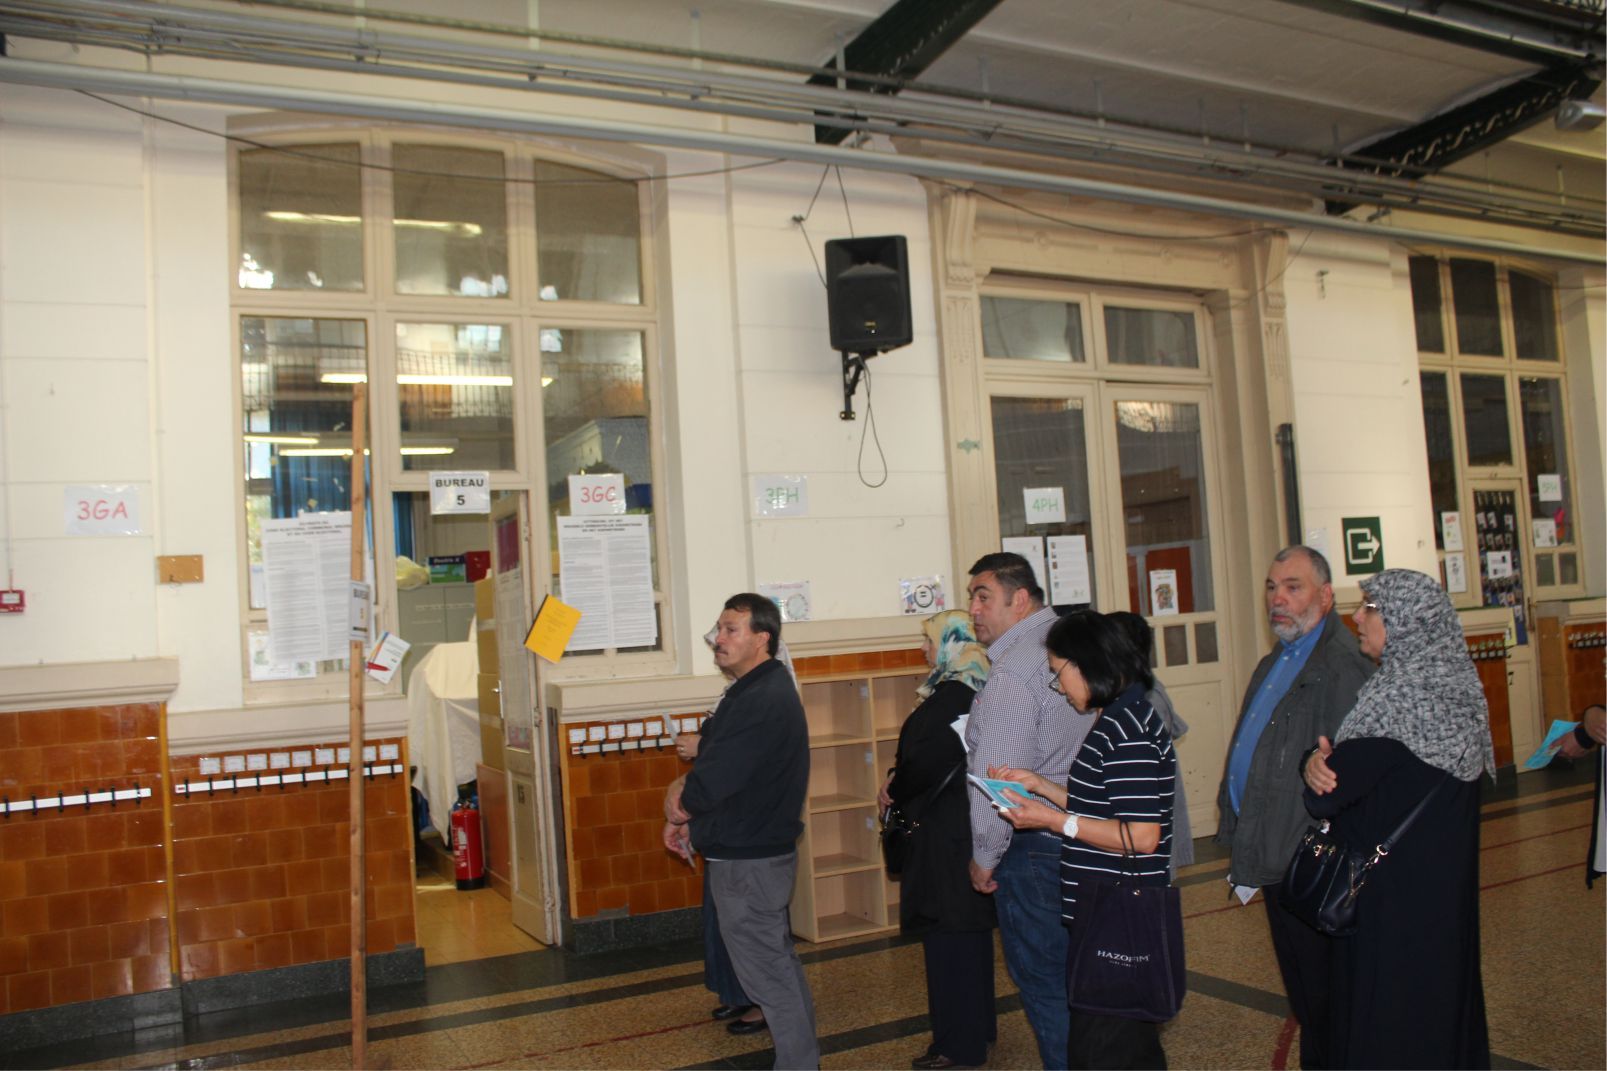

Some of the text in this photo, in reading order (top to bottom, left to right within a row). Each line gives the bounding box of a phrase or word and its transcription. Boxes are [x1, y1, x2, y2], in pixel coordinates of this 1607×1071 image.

[435, 478, 484, 488] BUREAU
[456, 495, 465, 506] 5
[580, 485, 616, 503] 3GC
[77, 499, 128, 520] 3GA
[1032, 497, 1059, 512] 4PH
